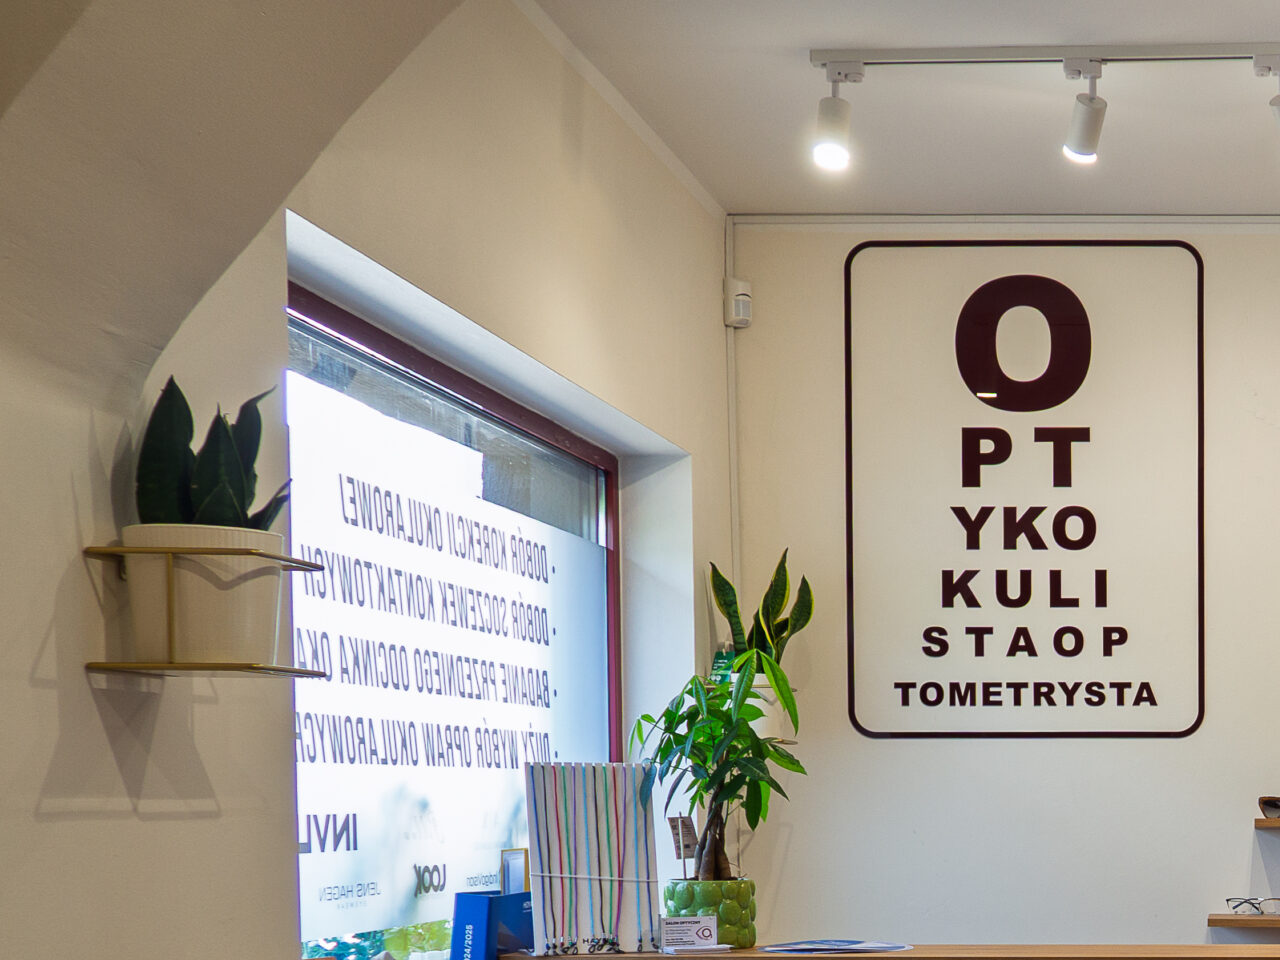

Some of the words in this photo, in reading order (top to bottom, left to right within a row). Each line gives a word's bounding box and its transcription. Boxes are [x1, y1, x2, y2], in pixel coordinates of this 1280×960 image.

[955, 274, 1092, 413] O
[950, 506, 1098, 551] YKO
[941, 569, 1108, 609] KULI
[922, 626, 1129, 658] STAOP
[894, 681, 1158, 707] TOMETRYSTA
